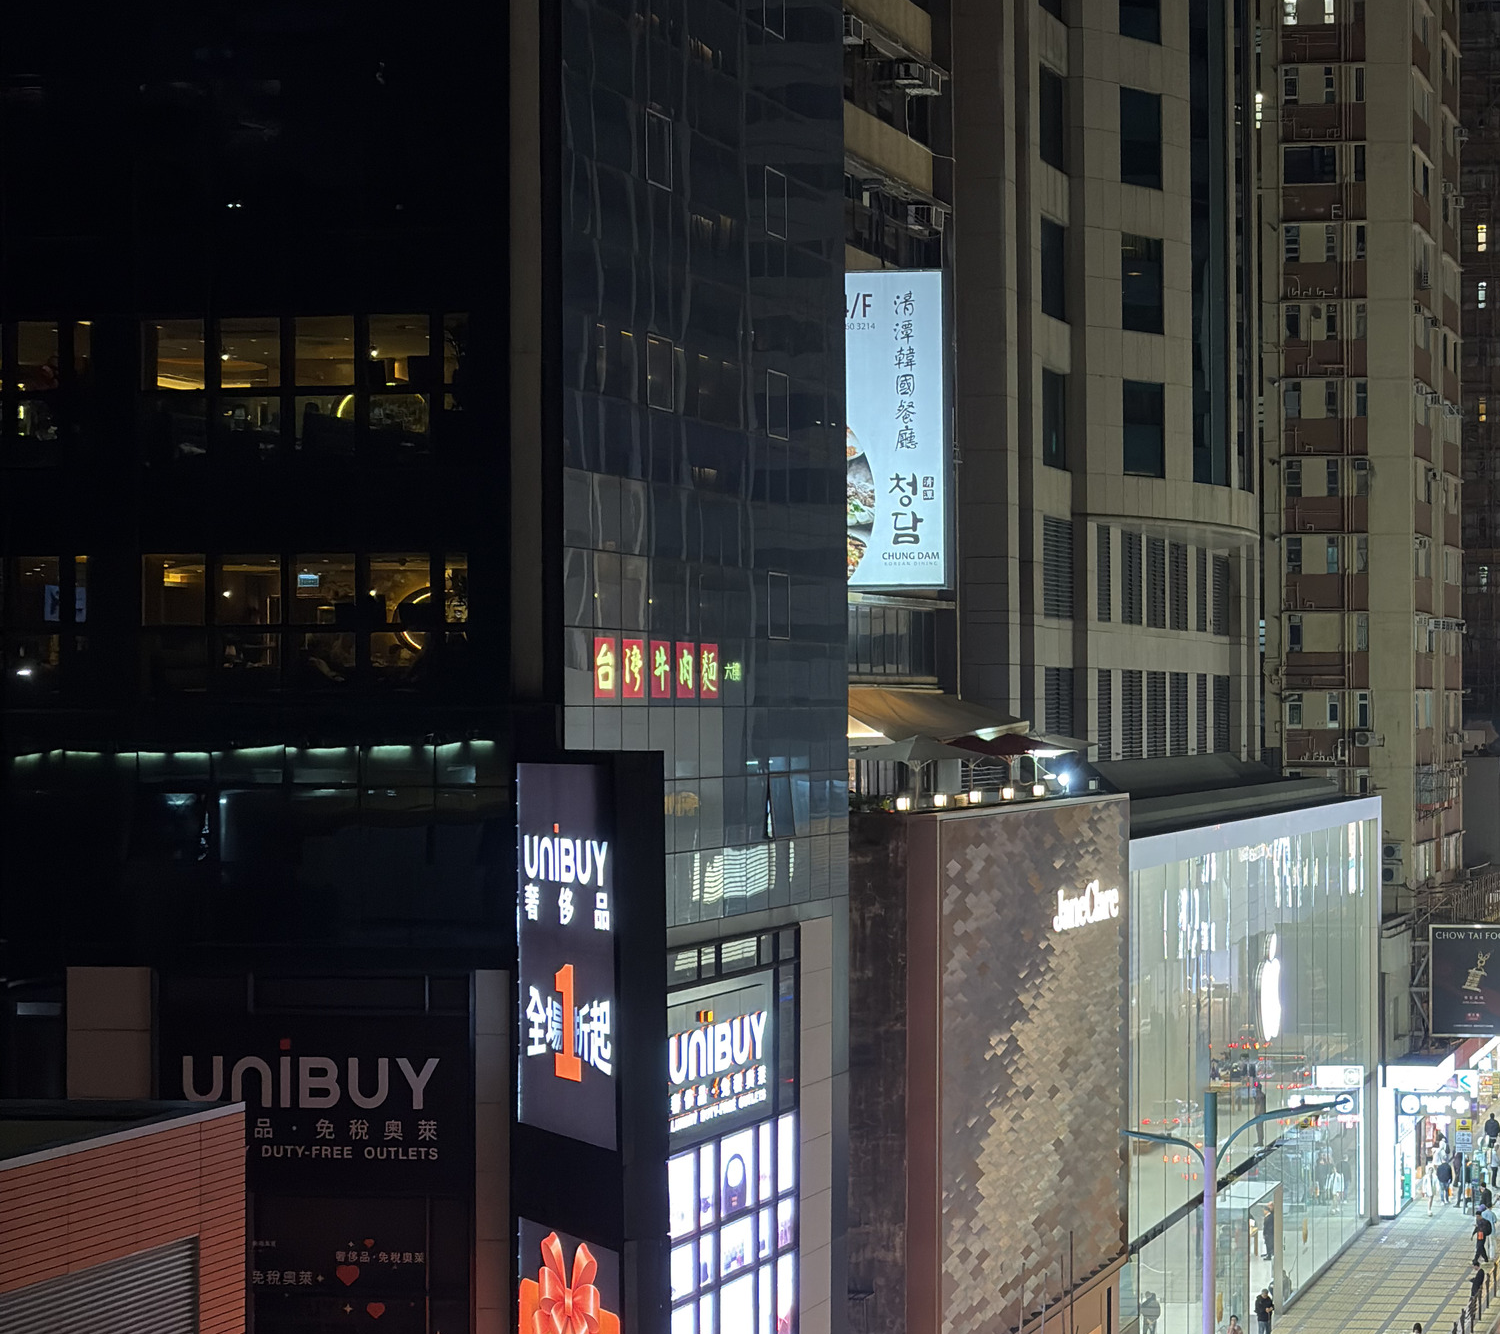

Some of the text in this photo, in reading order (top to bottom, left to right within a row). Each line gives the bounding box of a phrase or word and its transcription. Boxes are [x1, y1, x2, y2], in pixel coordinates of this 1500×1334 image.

[846, 292, 873, 319] /F
[857, 322, 876, 330] 3214
[893, 290, 919, 452] 清潭韓國餐廳
[888, 472, 924, 545] 청담
[881, 551, 940, 561] CHUNG DAM
[596, 642, 718, 692] 台灣牛肉麵
[523, 882, 610, 932] 奢侈品
[1435, 931, 1465, 940] CHOW
[1467, 931, 1483, 940] TAI
[261, 1145, 439, 1160] DUTY-FREE OUTLETS
